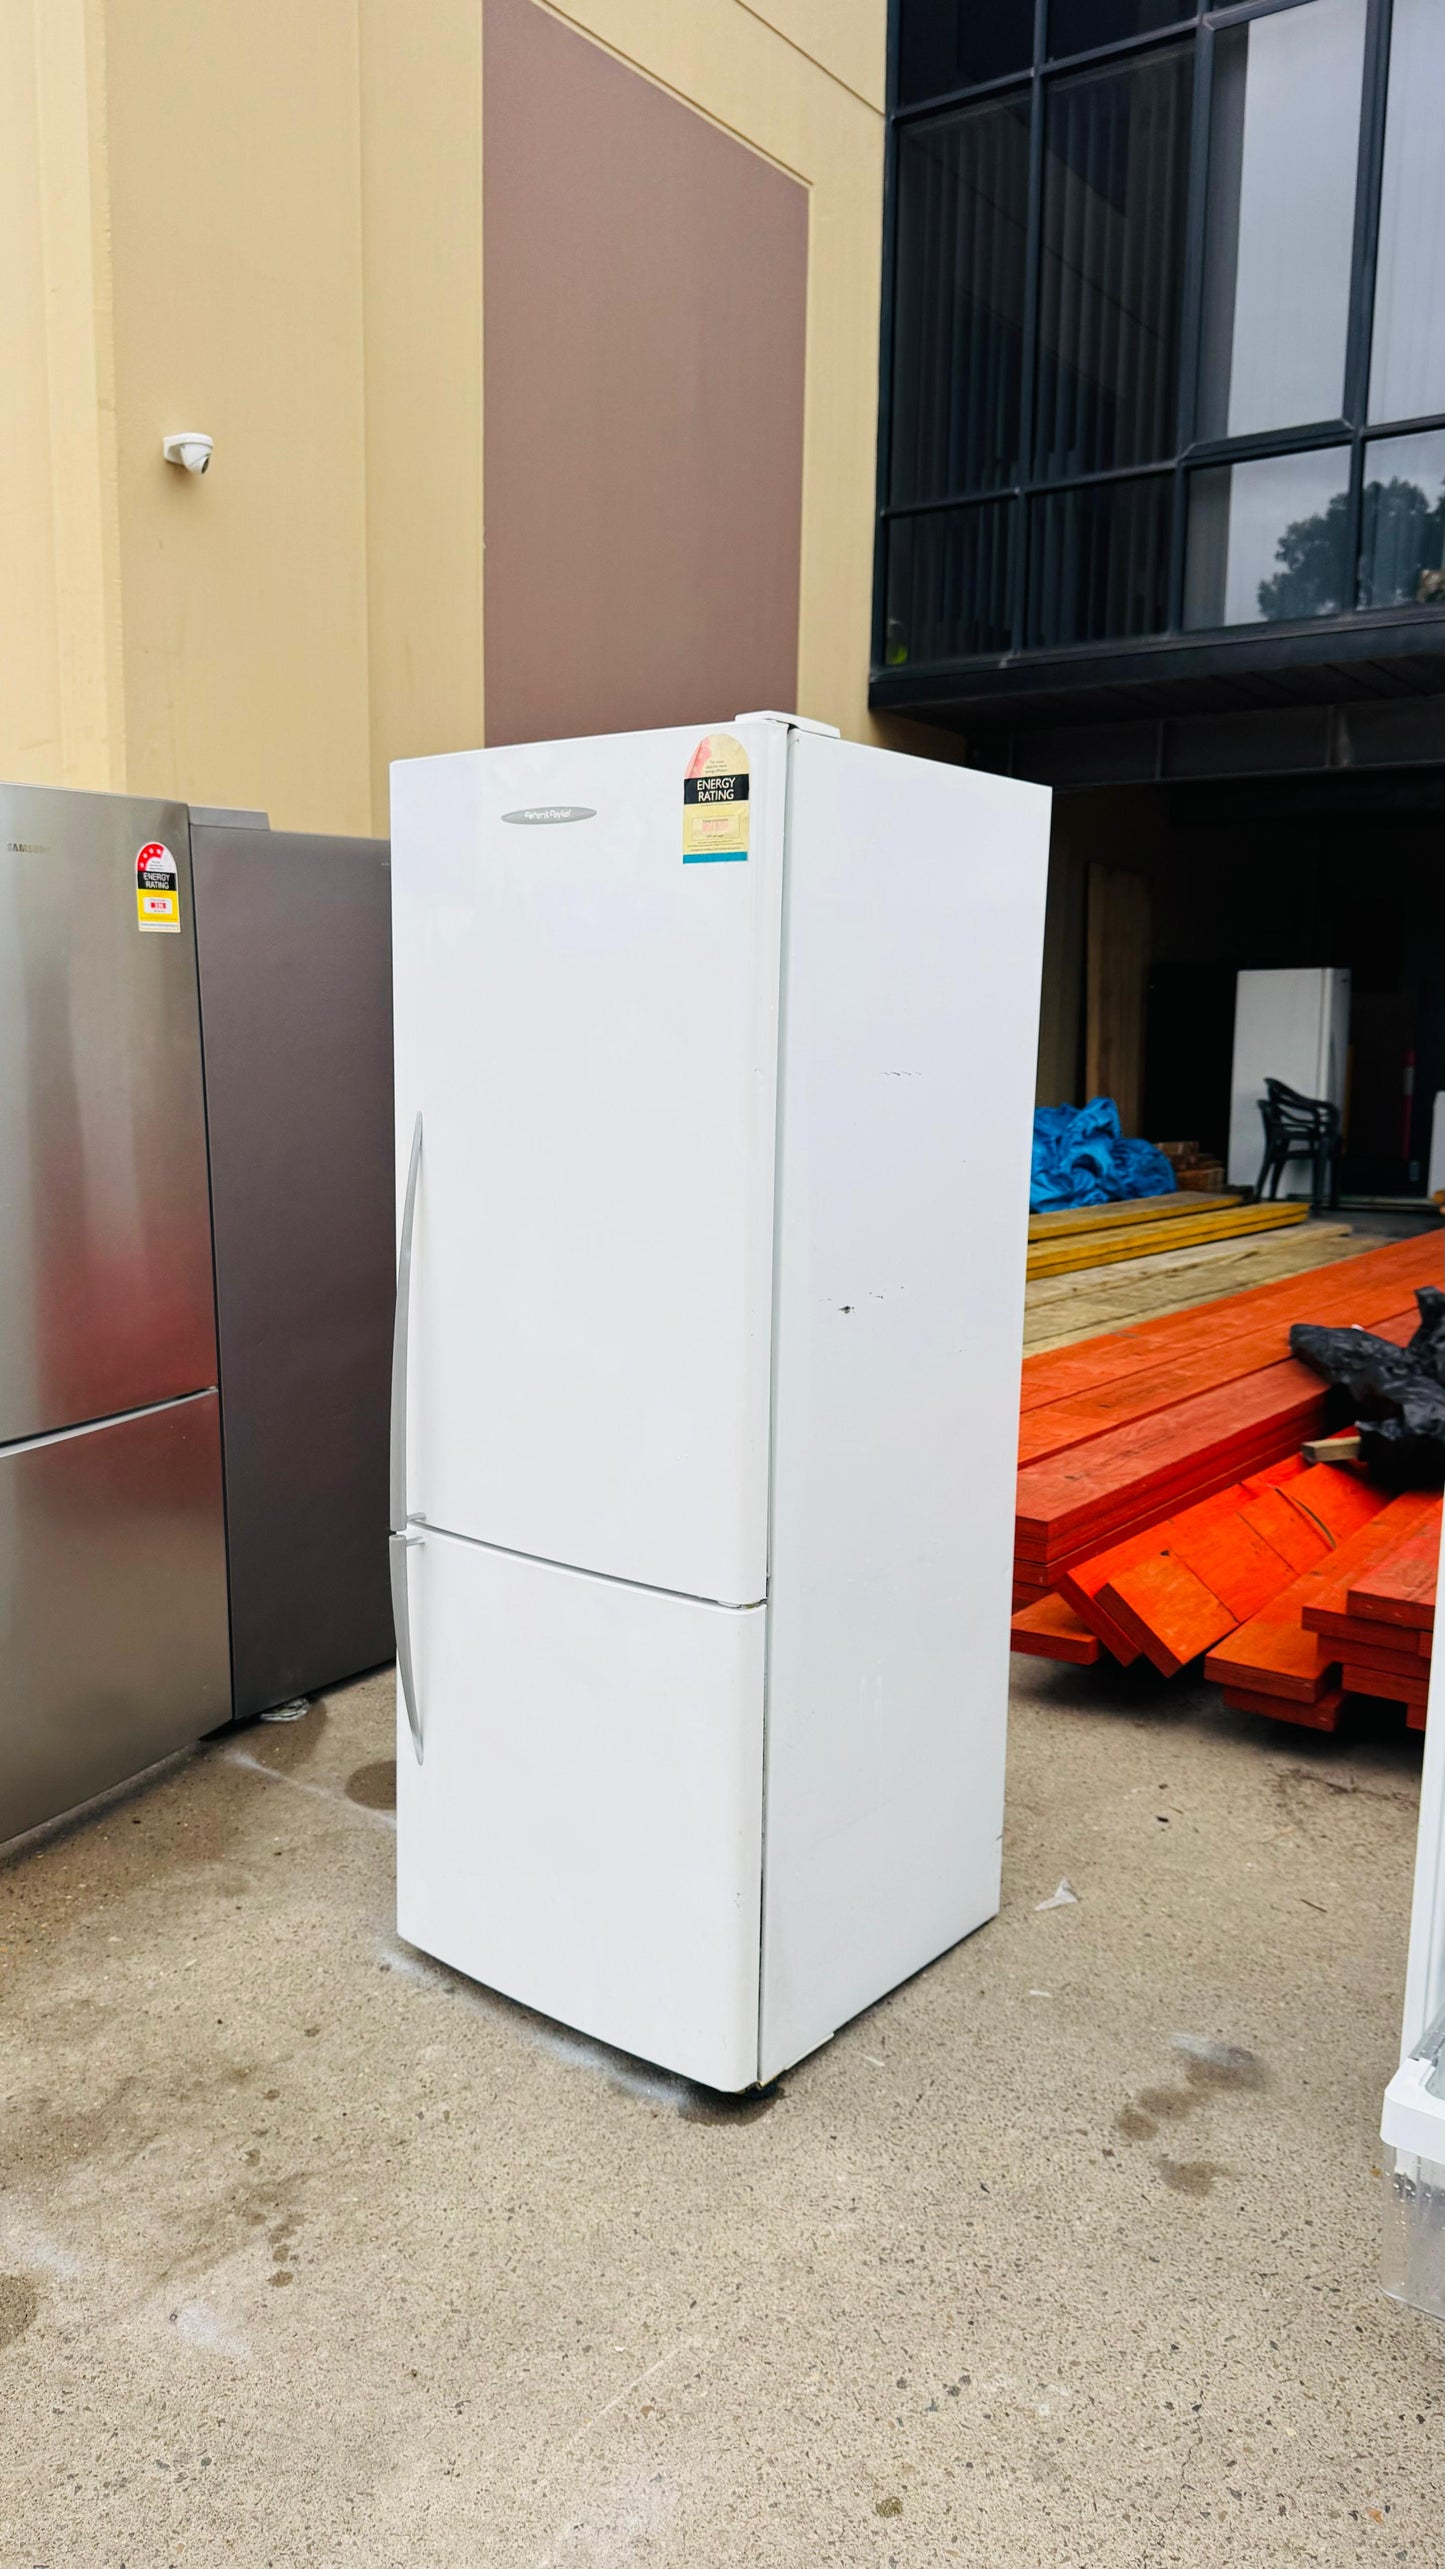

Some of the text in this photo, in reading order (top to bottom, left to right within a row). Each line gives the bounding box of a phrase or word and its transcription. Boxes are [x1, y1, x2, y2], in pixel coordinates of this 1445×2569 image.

[697, 777, 735, 791] ENERGY
[698, 789, 735, 802] RATING
[143, 872, 171, 882] ENERGY
[145, 880, 170, 890] RATING
